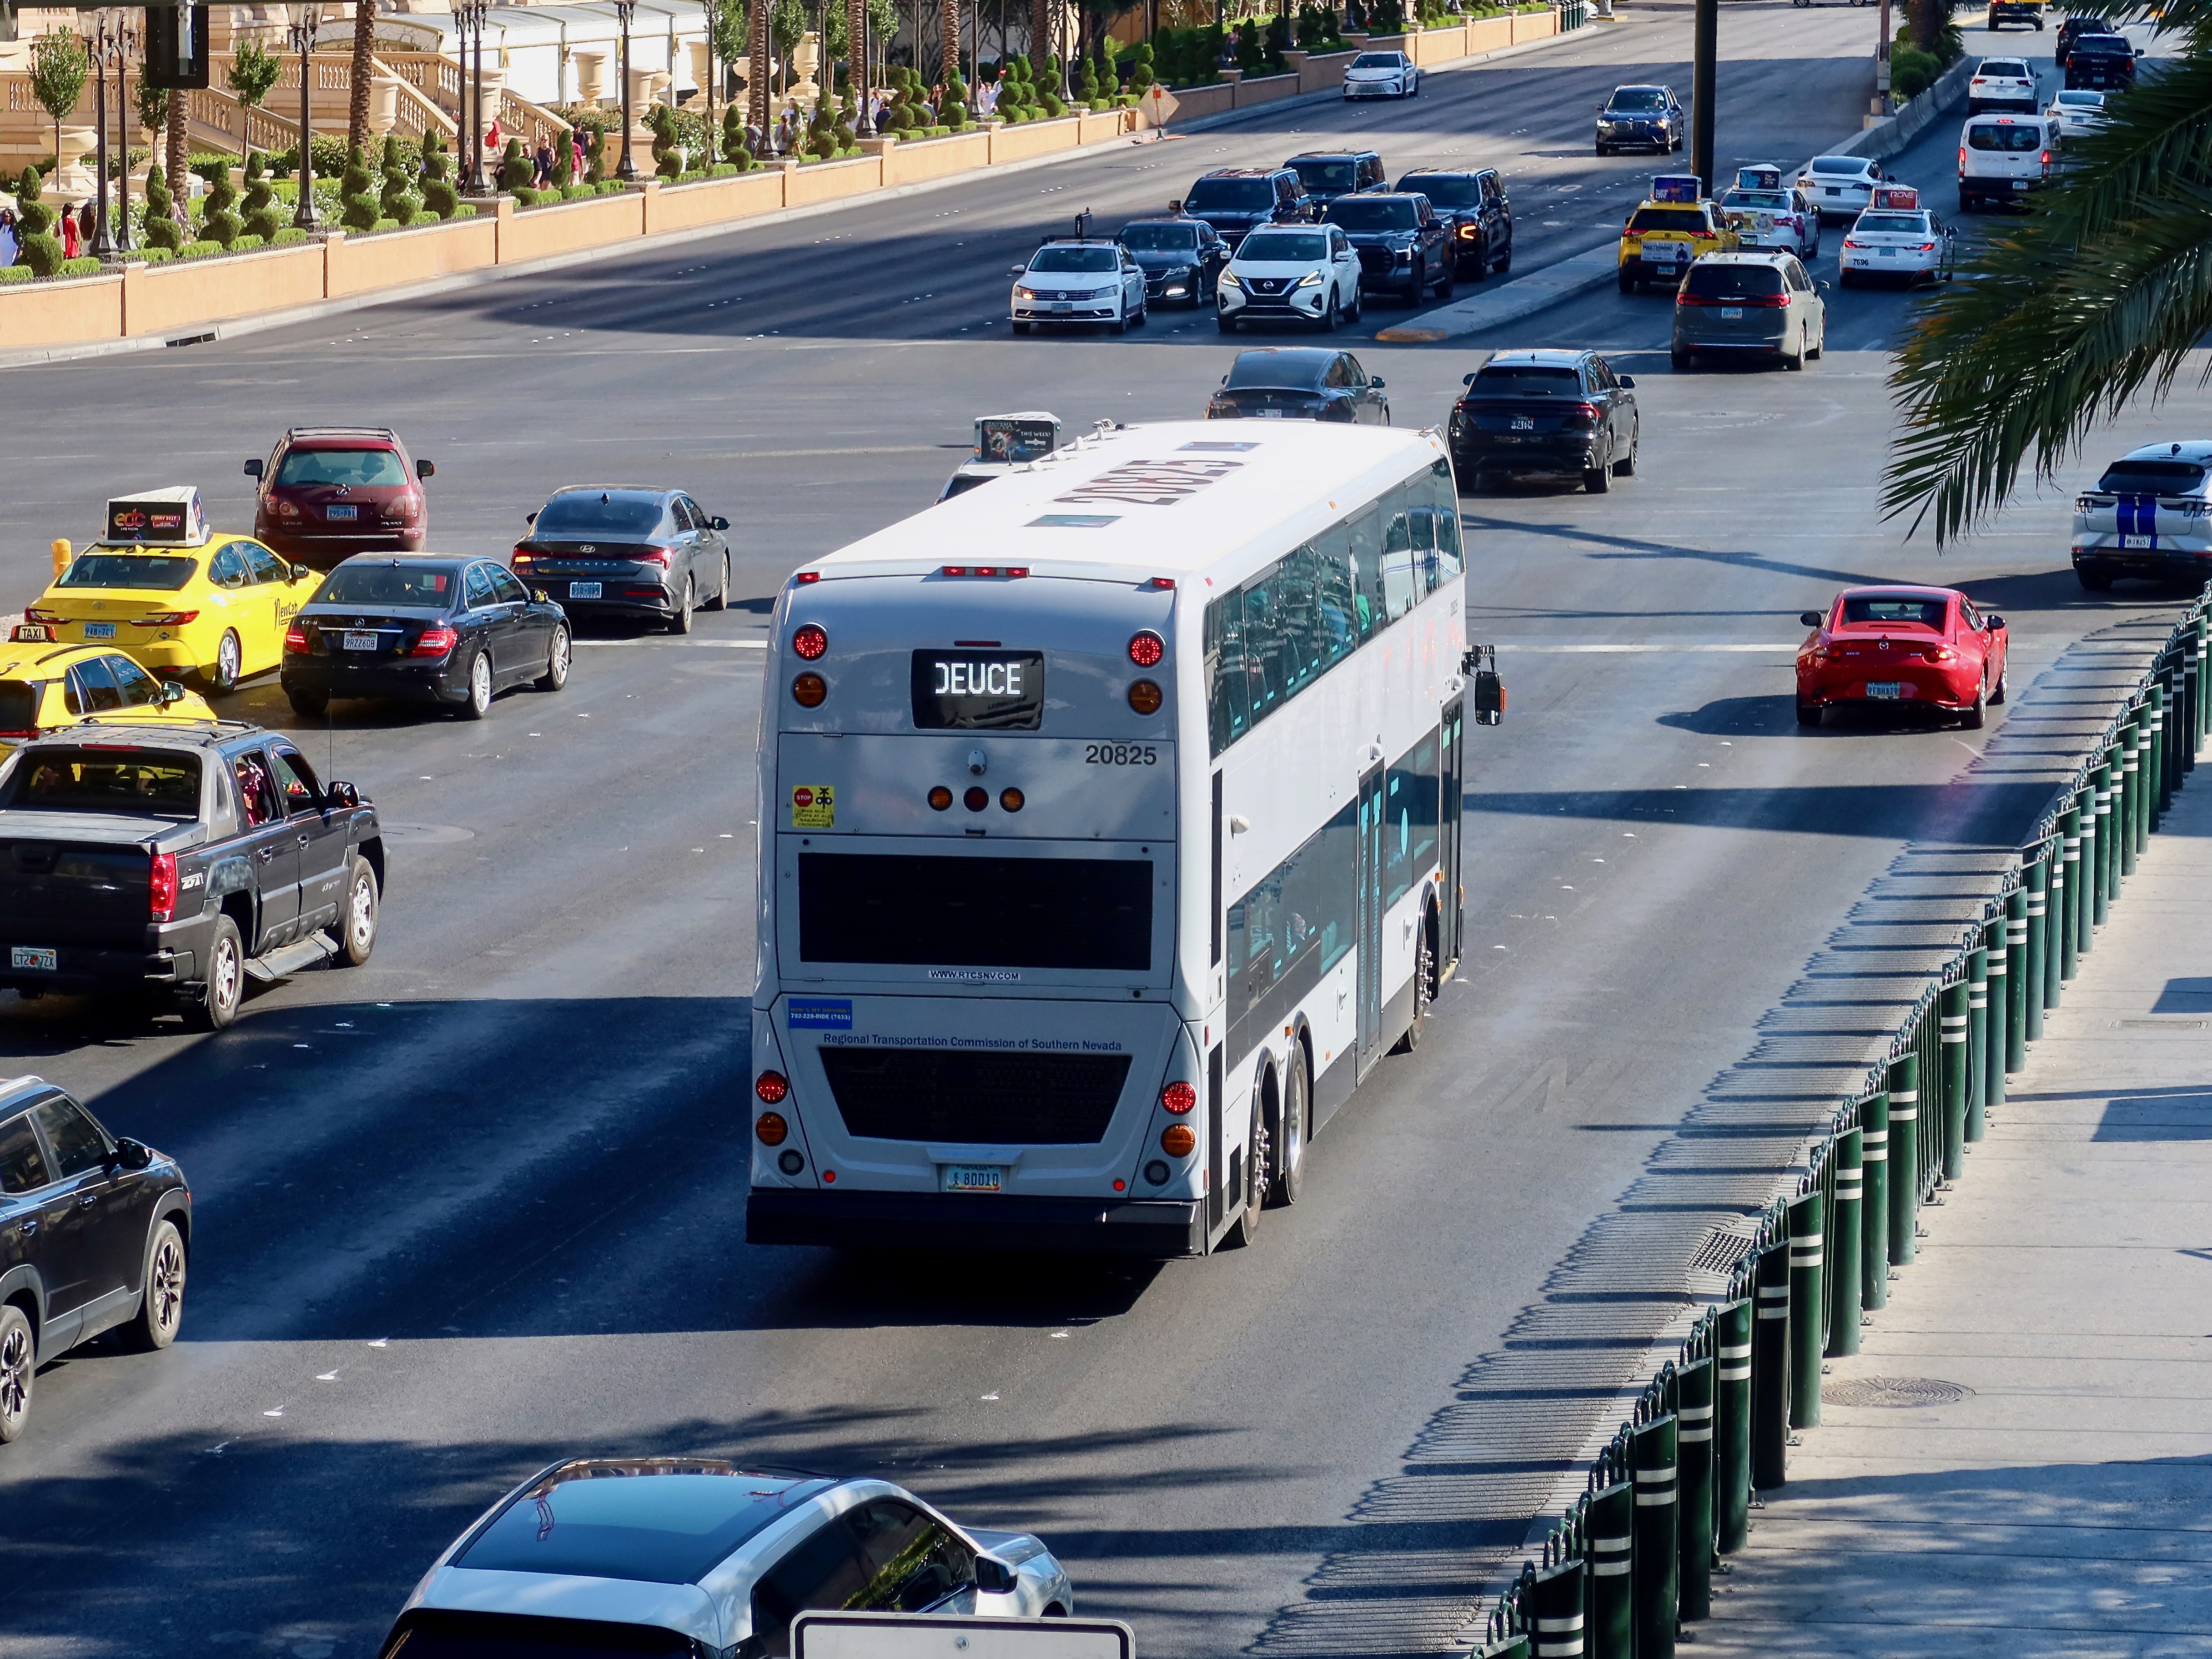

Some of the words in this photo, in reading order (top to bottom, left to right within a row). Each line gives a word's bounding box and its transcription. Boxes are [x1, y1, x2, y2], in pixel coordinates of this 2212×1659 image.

[22, 628, 41, 639] TAXI
[1086, 744, 1157, 766] 20825
[930, 970, 1019, 980] WWW.RTCSNV.COM
[824, 1033, 869, 1045] Regional
[872, 1034, 947, 1046] Transportation
[950, 1036, 1015, 1048] Commission
[1018, 1039, 1029, 1048] of
[1031, 1039, 1079, 1049] Southern
[1082, 1041, 1121, 1051] Nevada
[964, 1172, 999, 1186] 80010
